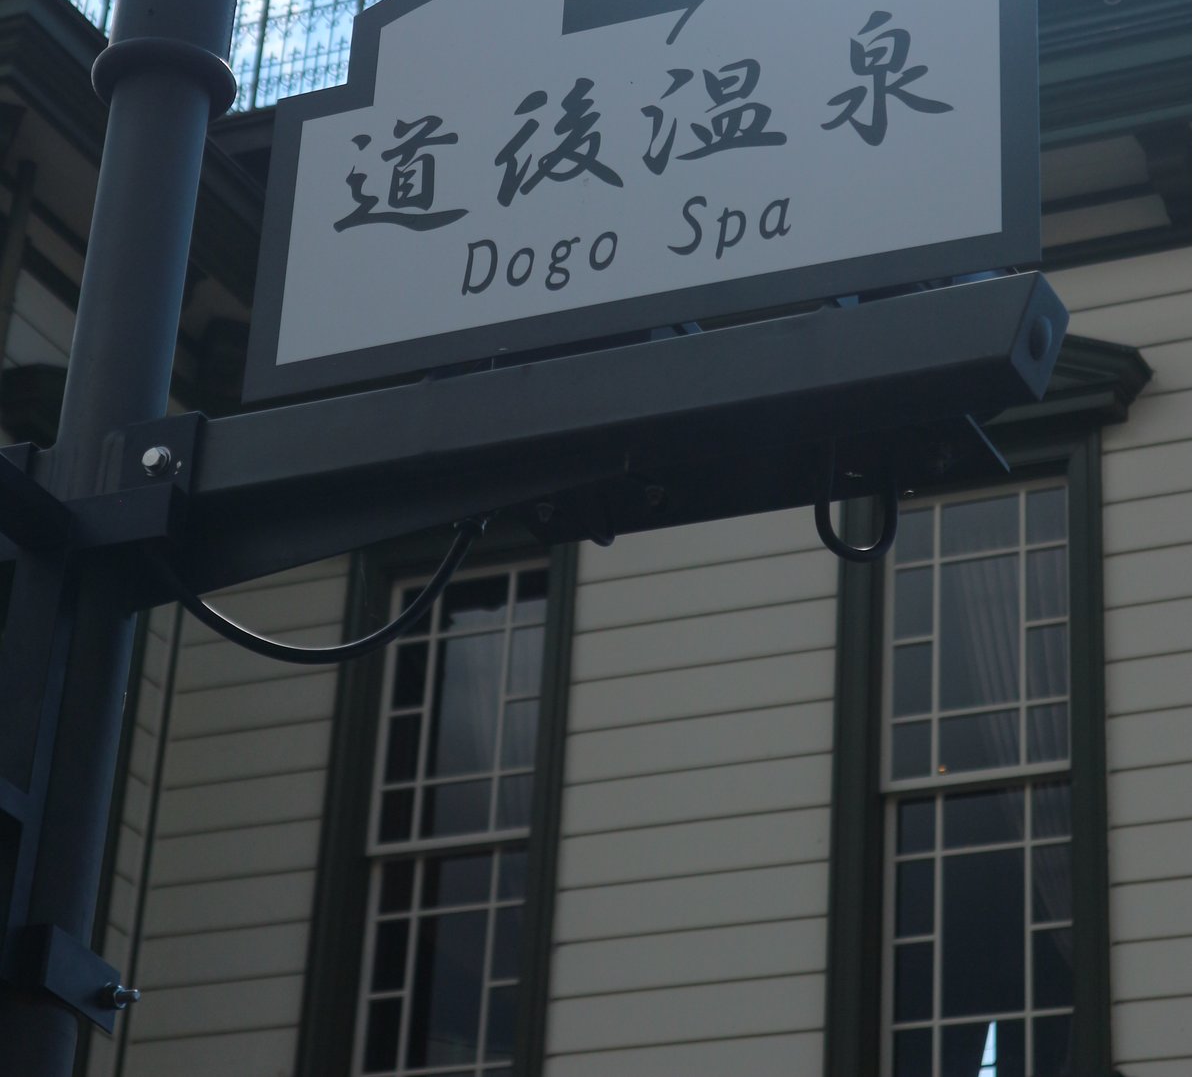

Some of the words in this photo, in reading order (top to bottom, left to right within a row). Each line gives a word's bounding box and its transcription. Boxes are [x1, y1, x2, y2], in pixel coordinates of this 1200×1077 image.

[333, 10, 954, 232] 道後温泉
[461, 230, 618, 296] Dogo
[666, 195, 792, 259] Spa
